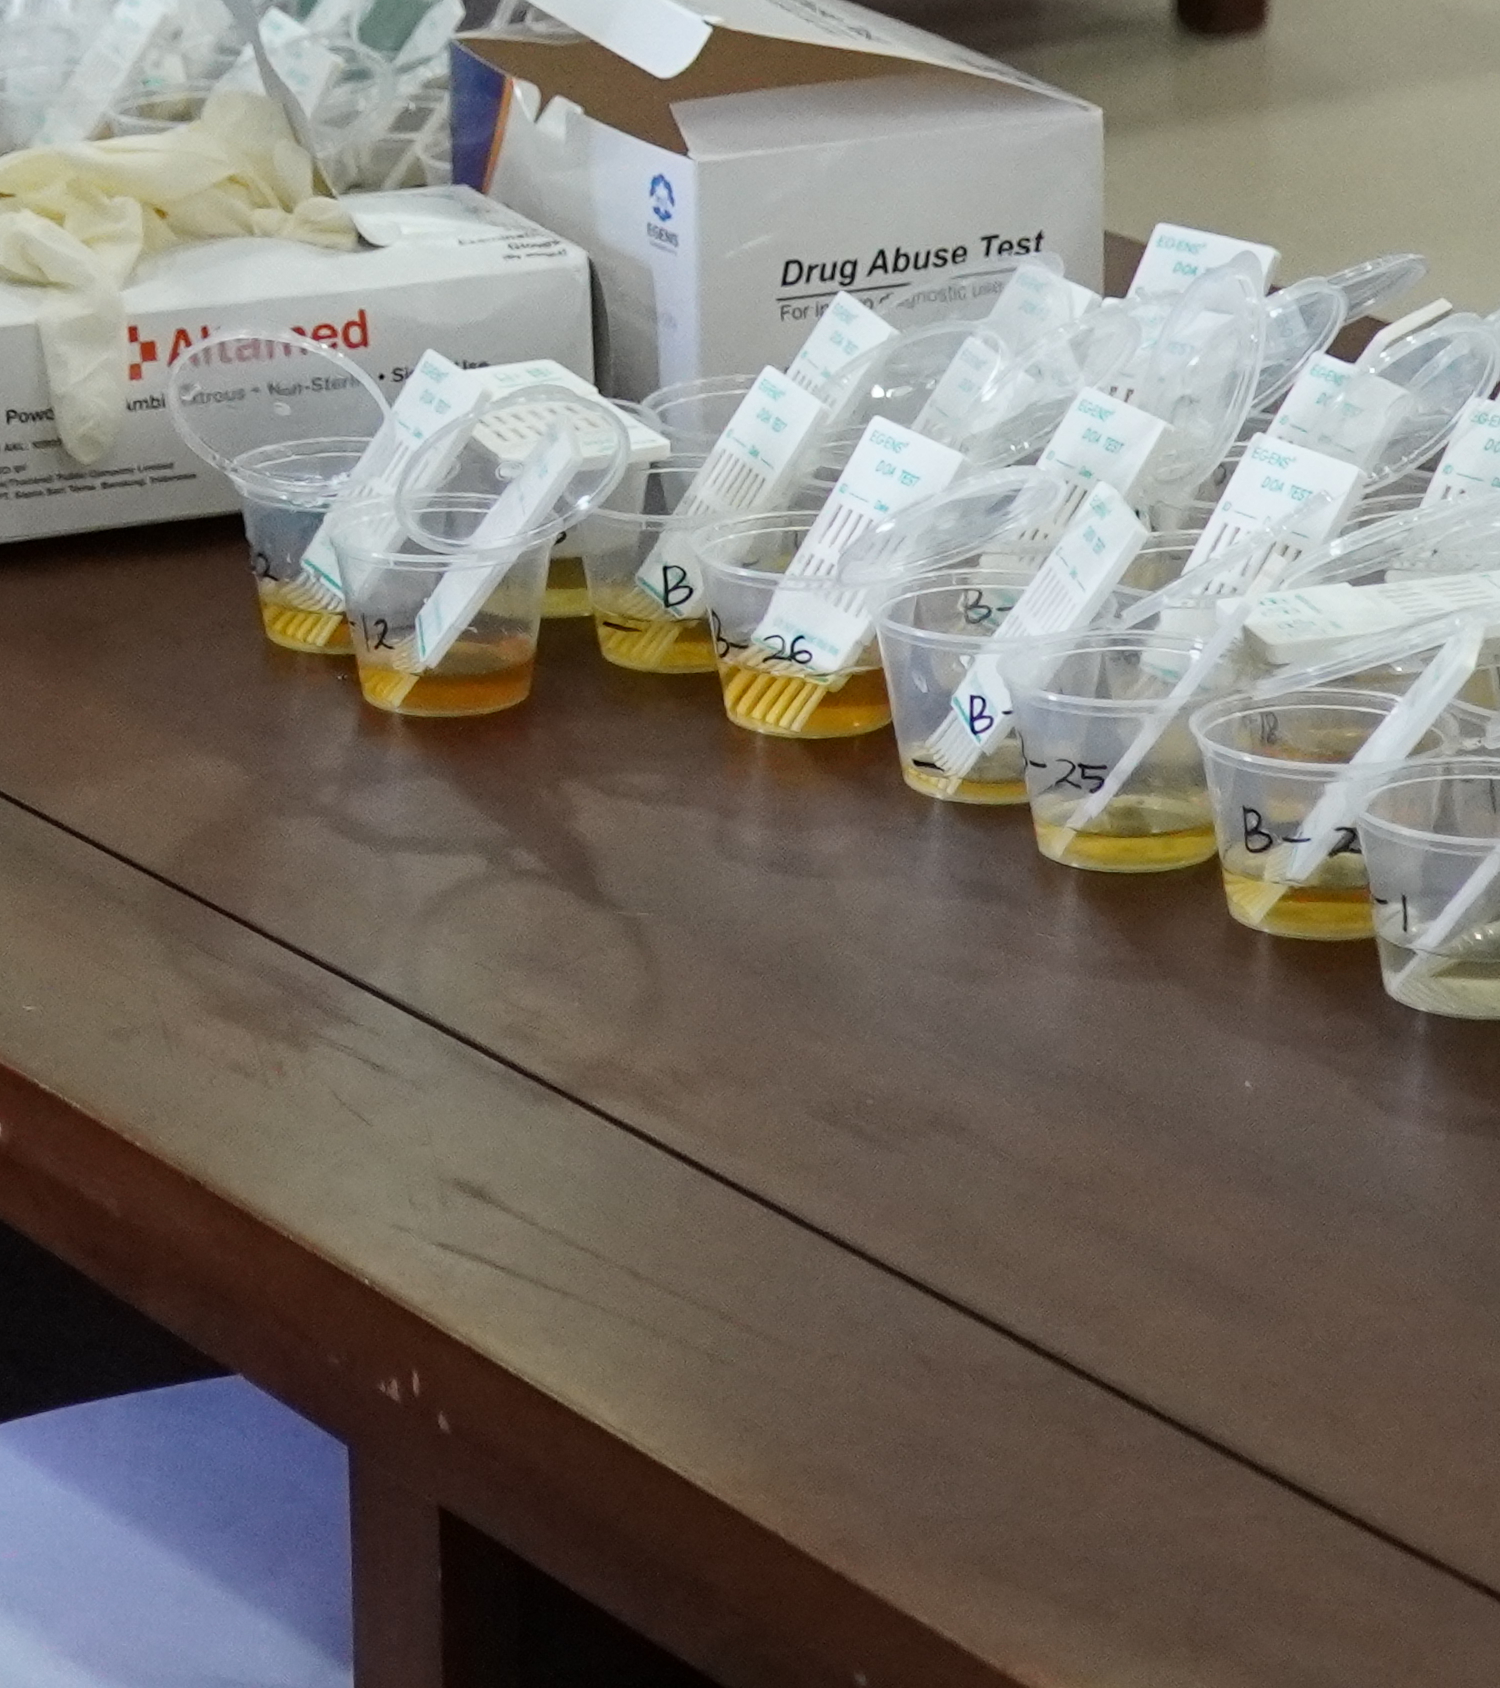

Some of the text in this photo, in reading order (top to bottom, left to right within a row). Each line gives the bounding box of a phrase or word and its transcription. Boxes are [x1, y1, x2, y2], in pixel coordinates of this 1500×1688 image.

[780, 229, 1045, 287] Drug Abuse Test
[780, 302, 809, 322] For
[1261, 476, 1313, 502] DOA TEST
